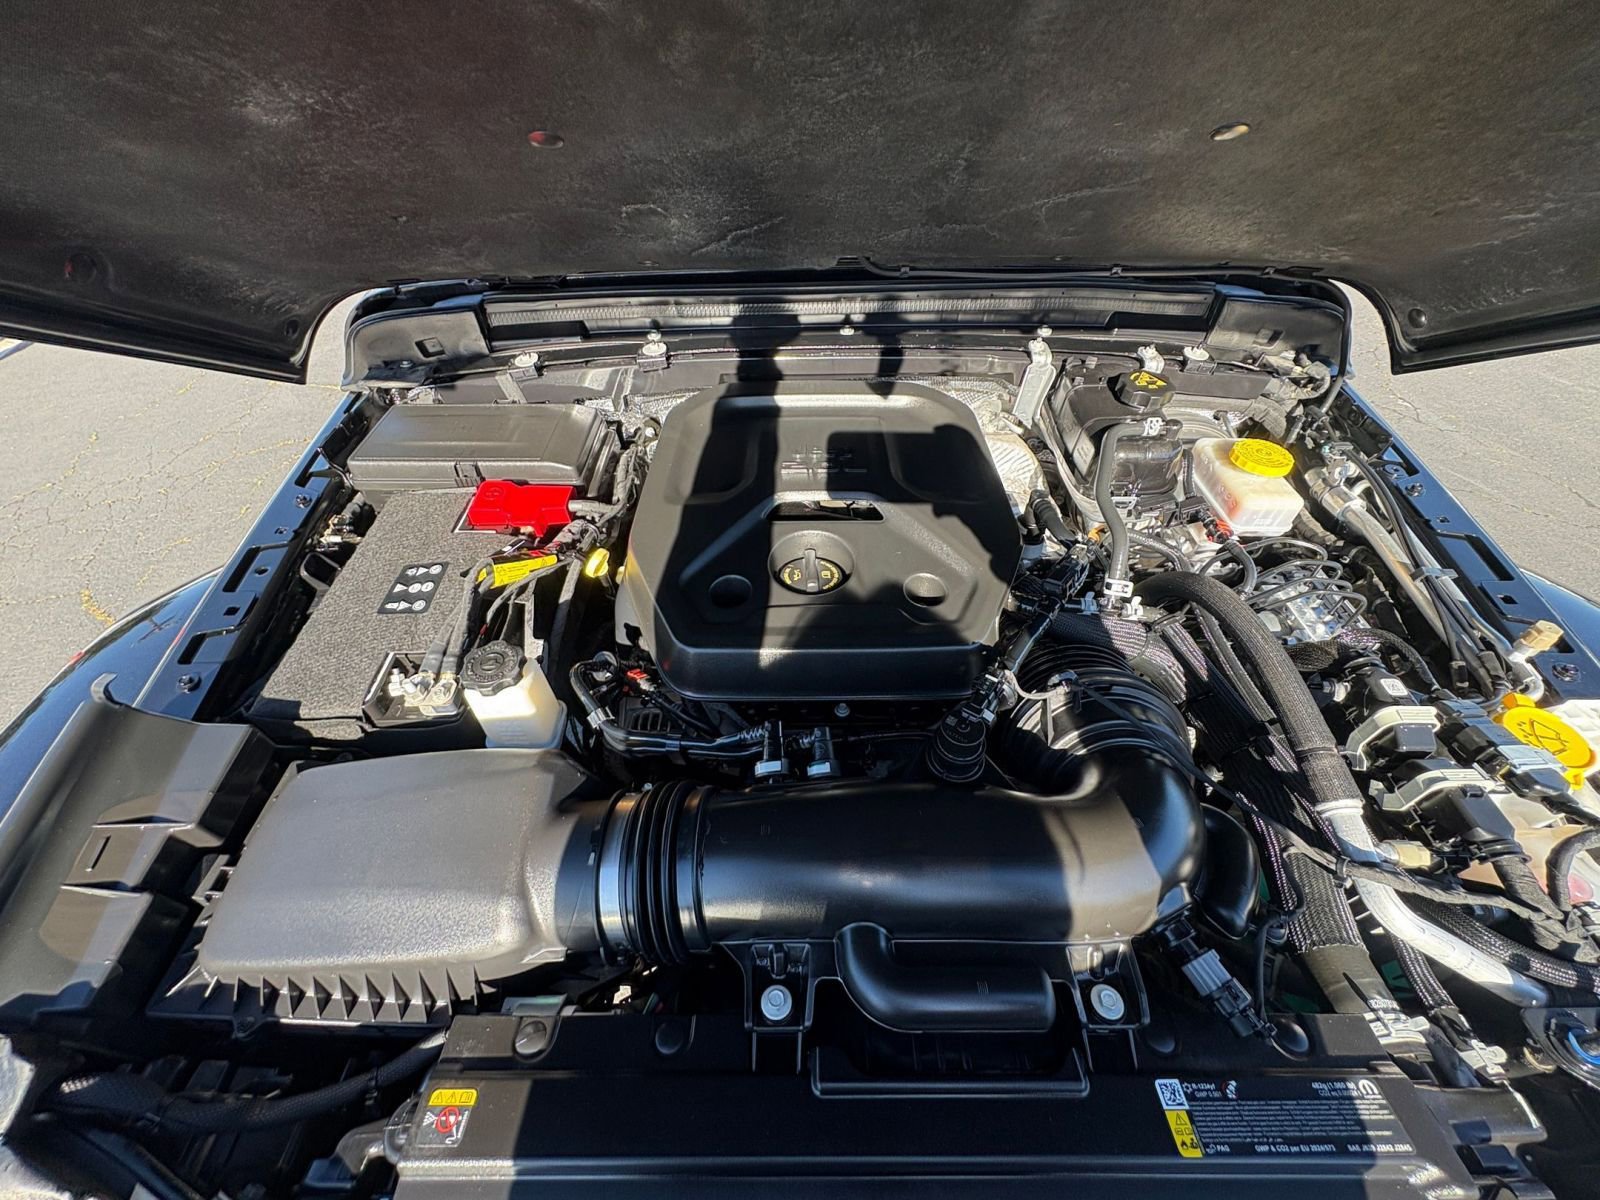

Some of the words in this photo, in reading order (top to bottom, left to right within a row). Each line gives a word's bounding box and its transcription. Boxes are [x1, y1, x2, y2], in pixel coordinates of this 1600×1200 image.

[1255, 1144, 1270, 1152] GWP
[1270, 1144, 1277, 1152] &
[1276, 1144, 1290, 1153] CO2
